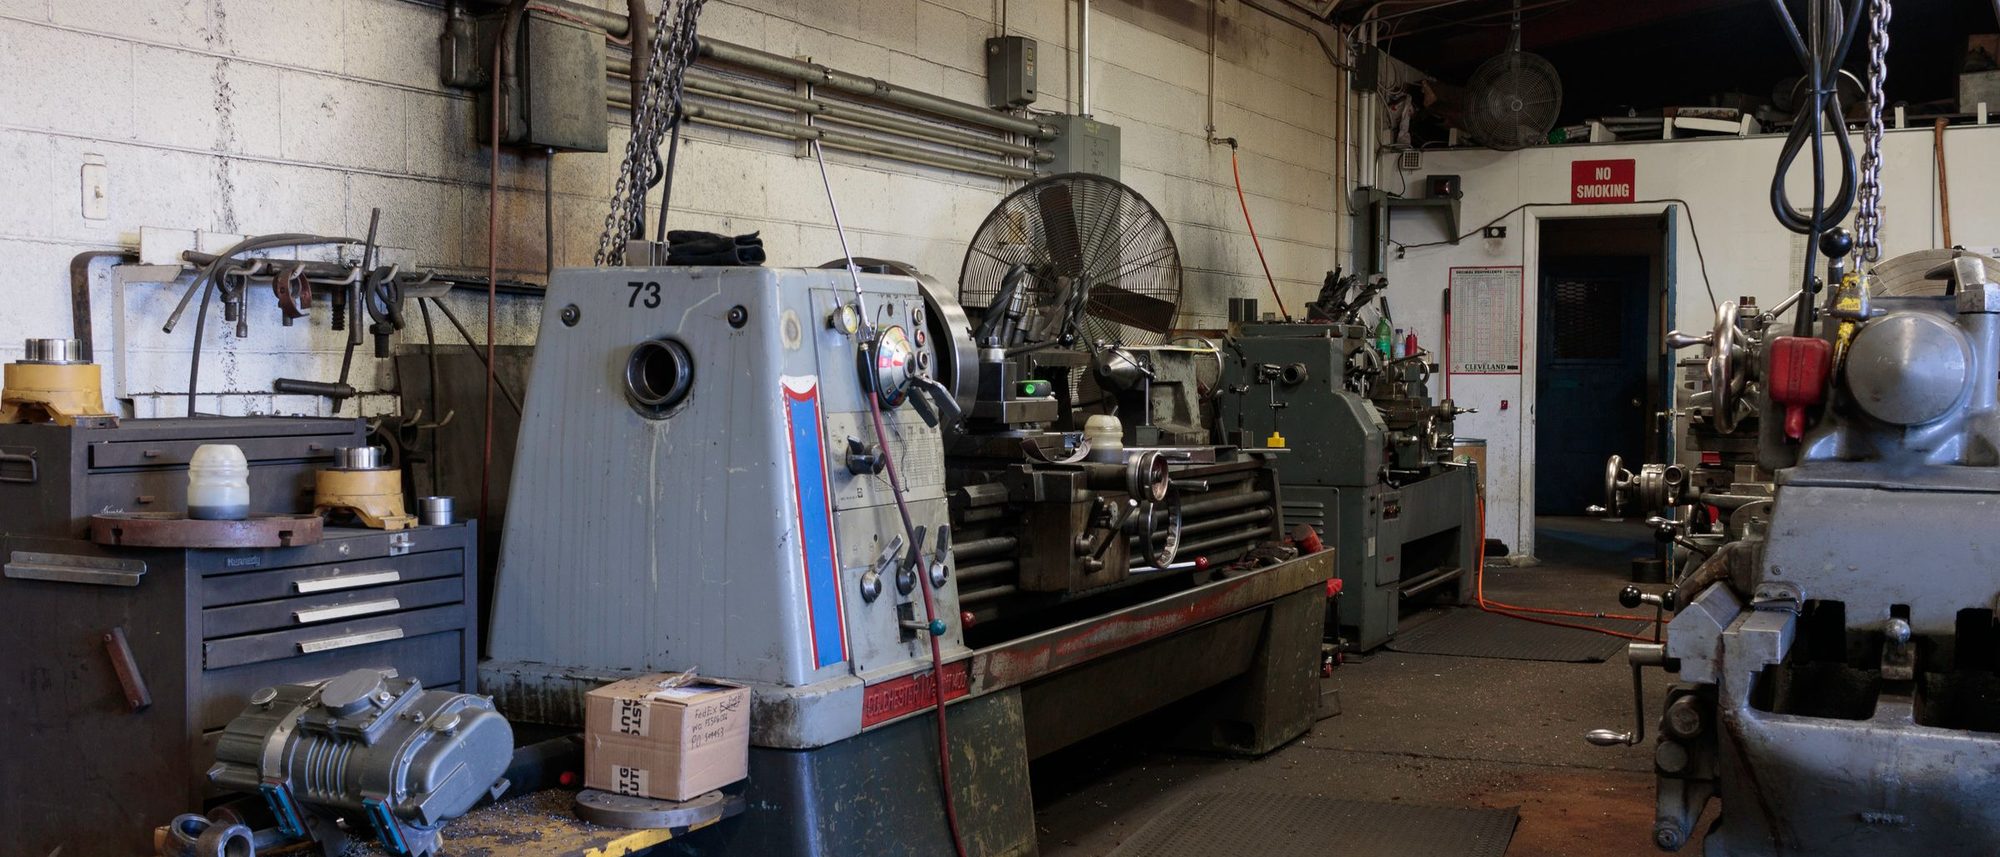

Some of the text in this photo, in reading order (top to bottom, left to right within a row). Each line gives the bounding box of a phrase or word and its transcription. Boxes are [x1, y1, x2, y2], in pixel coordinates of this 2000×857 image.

[1595, 166, 1612, 181] NO
[1576, 183, 1630, 198] SMOKING
[627, 281, 662, 309] 73
[631, 699, 642, 727] AST
[694, 705, 718, 719] FedEx
